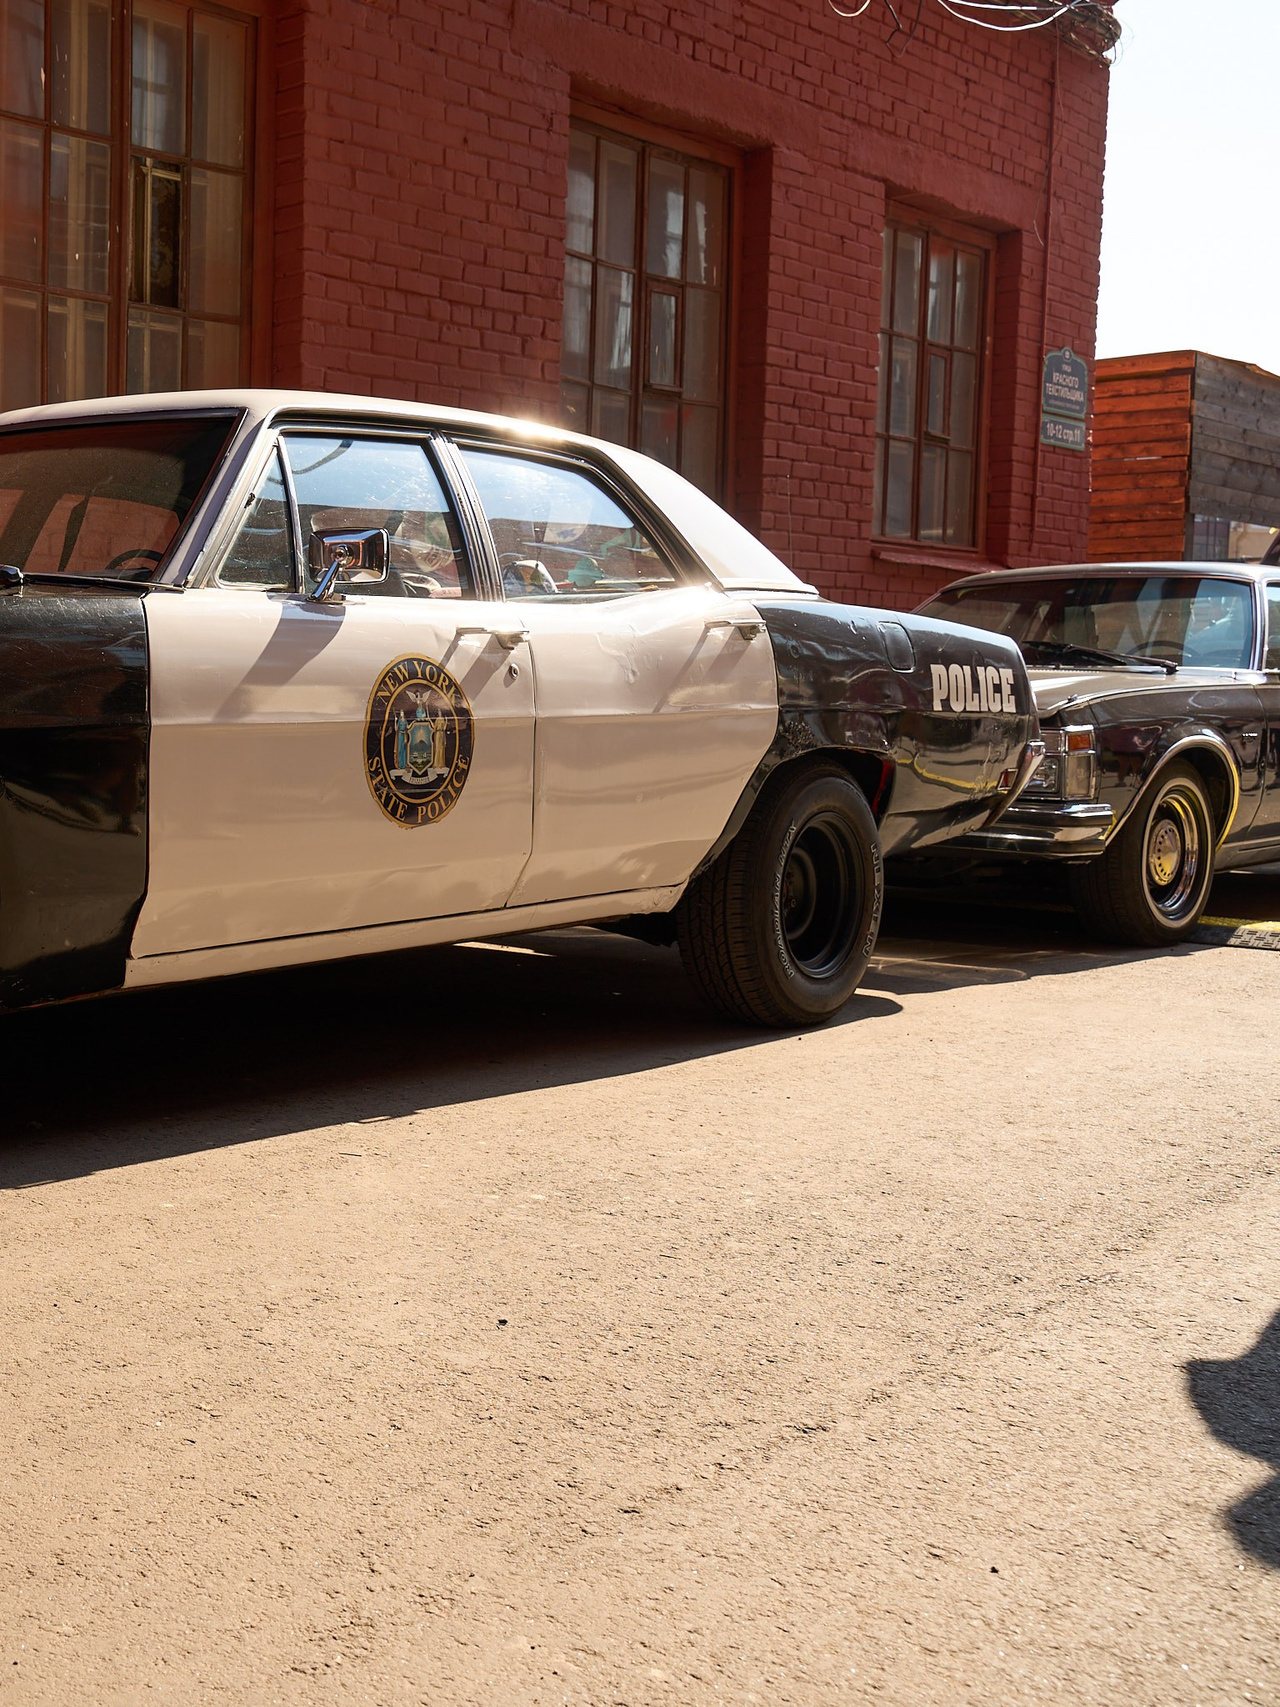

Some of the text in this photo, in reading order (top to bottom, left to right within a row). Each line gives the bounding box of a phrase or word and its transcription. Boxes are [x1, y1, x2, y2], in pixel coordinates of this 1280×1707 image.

[1052, 371, 1079, 388] КРАСНОГО
[1046, 422, 1062, 439] 10-12
[377, 660, 462, 708] NEW YORK
[930, 663, 1017, 714] POLICE
[368, 754, 470, 823] STATE POLICE
